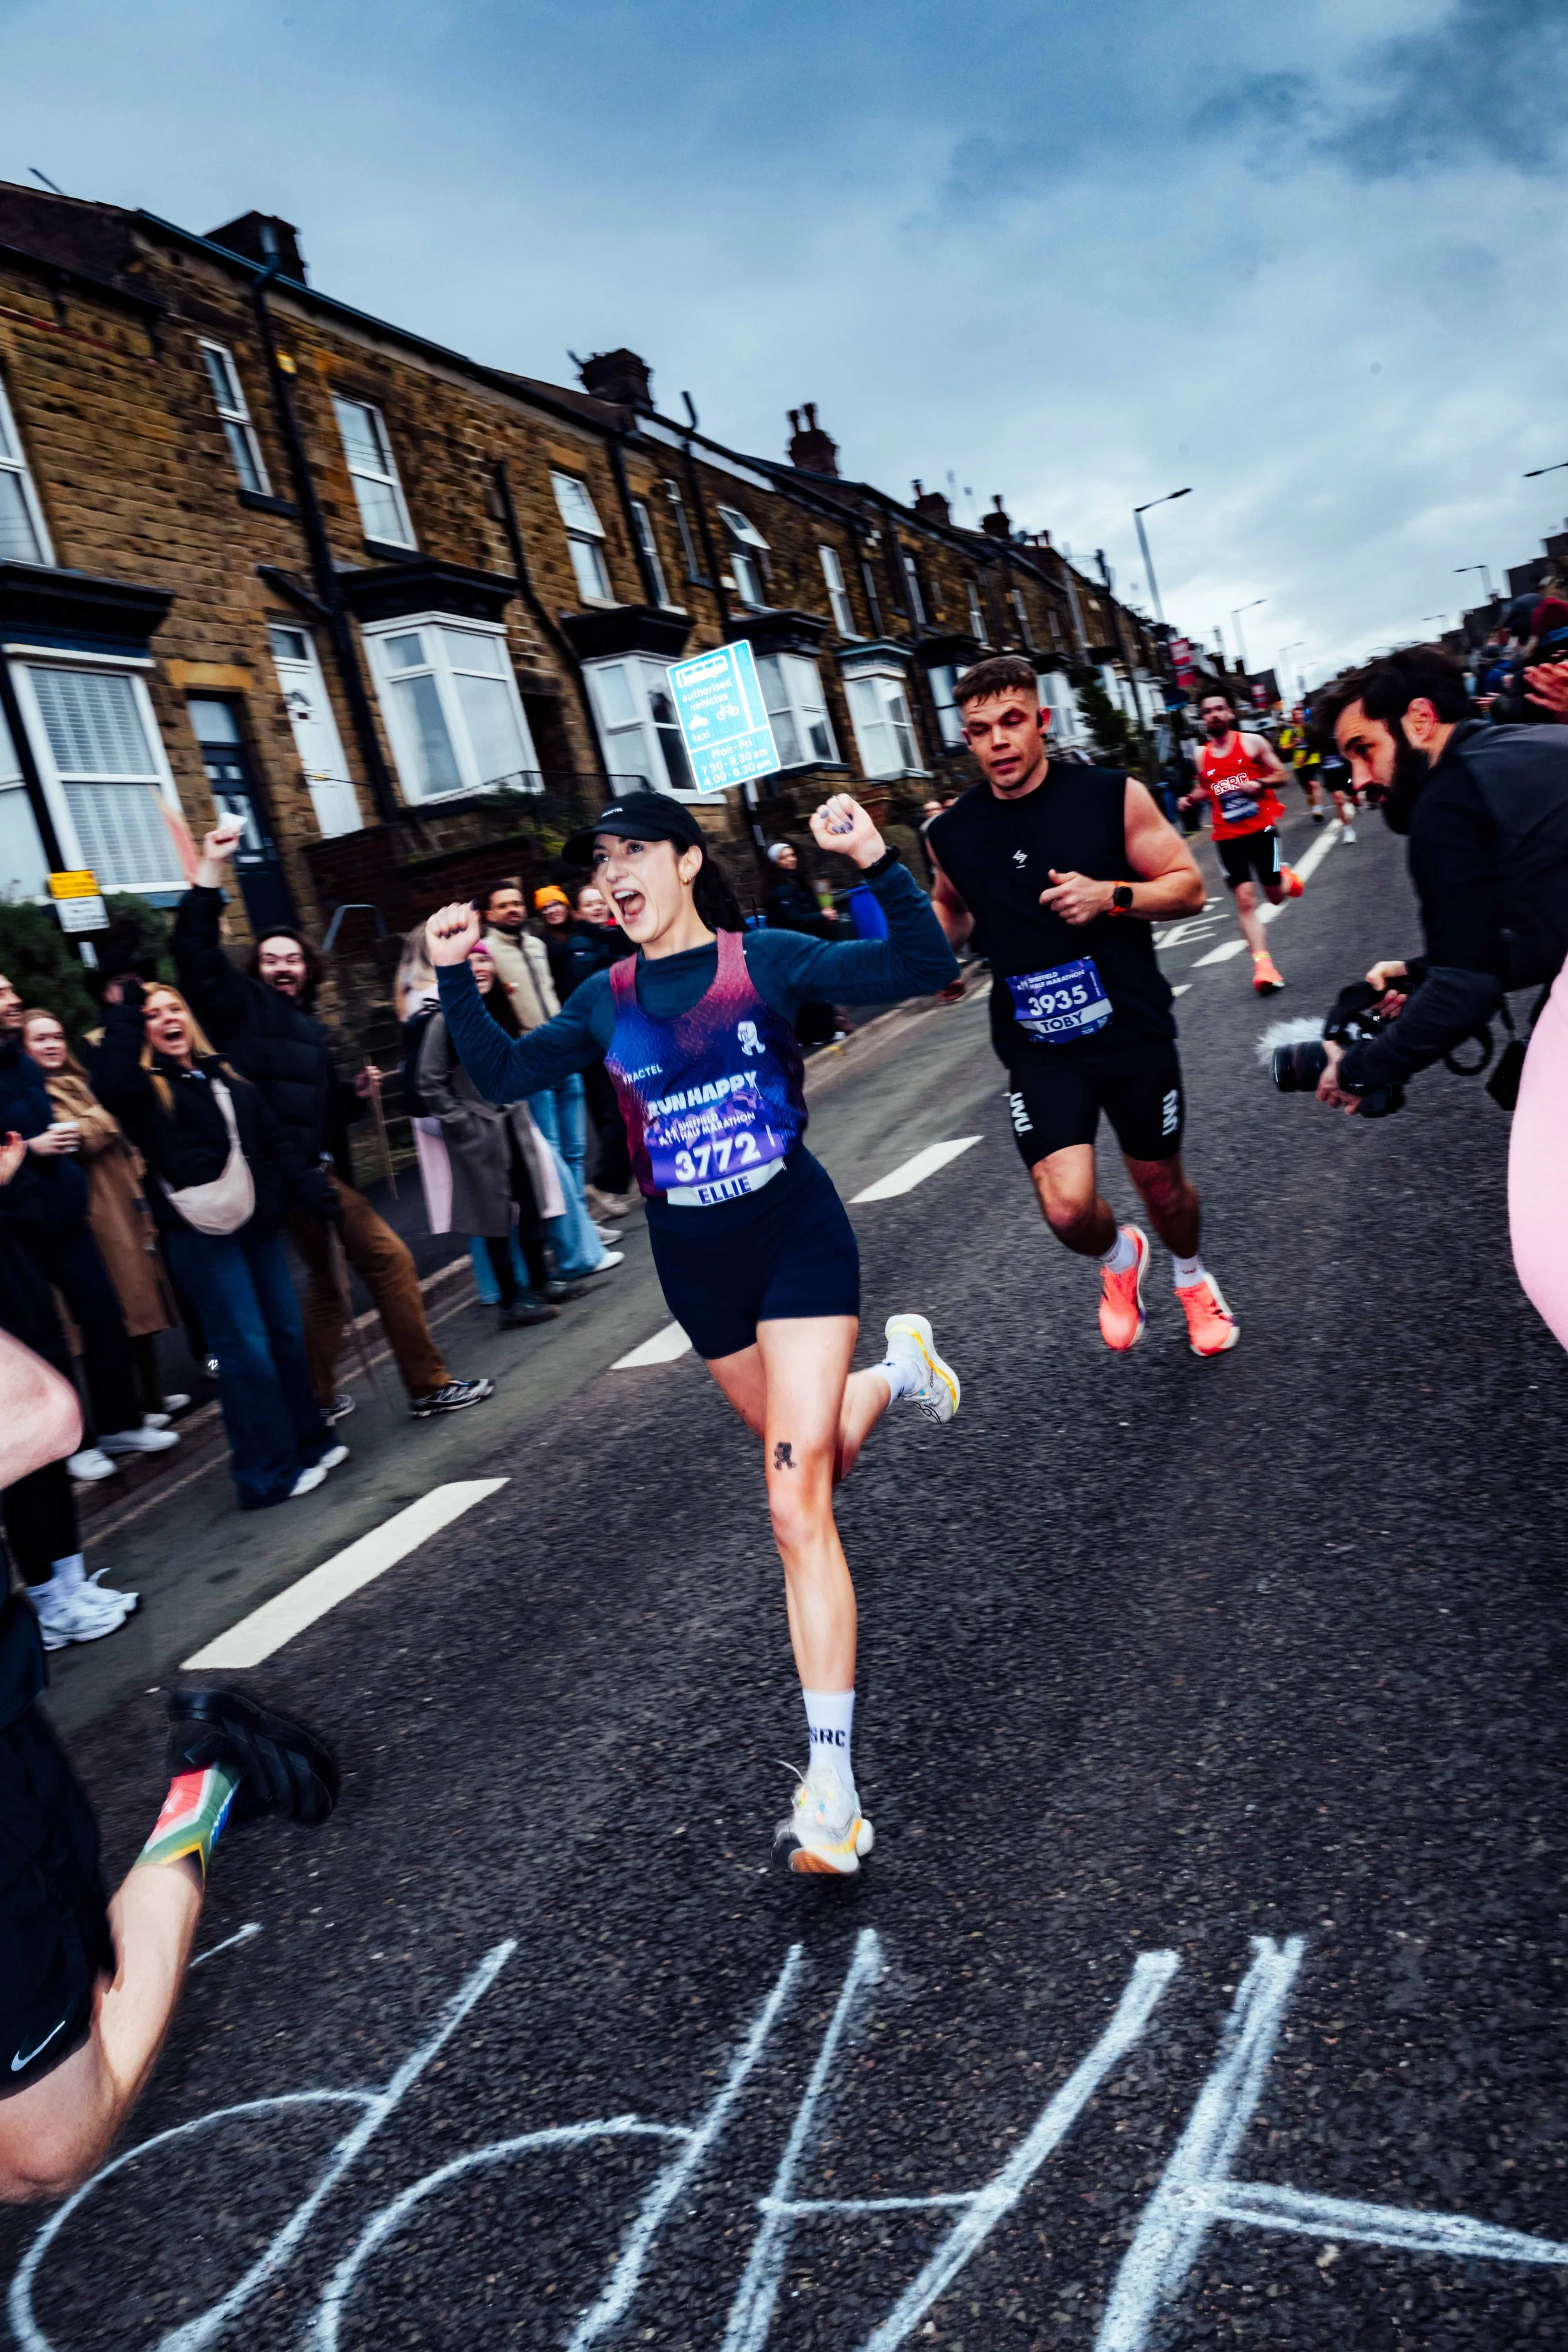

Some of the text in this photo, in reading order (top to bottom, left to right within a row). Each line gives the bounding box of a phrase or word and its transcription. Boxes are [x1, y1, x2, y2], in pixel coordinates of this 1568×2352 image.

[682, 678, 733, 702] authorised
[691, 693, 728, 711] vehicles
[692, 729, 711, 743] taxi
[711, 746, 733, 758] Mon
[739, 737, 752, 750] Fri
[701, 761, 723, 775] 7.30
[729, 751, 752, 766] 9.30
[753, 748, 768, 759] am
[704, 771, 727, 786] 4.00
[733, 762, 756, 777] 6.30
[757, 759, 772, 771] pm
[1028, 972, 1058, 983] SHEFFIELD
[1030, 982, 1046, 990] HALF
[1046, 970, 1085, 986] MARATHON
[1028, 984, 1088, 1016] 3935
[1041, 1011, 1083, 1031] TOBY
[647, 1071, 757, 1121] RUN HAPPY
[678, 1113, 719, 1131] SHEFFIELD
[680, 1111, 755, 1141] HALF MARATHON
[675, 1131, 761, 1182] 3772
[697, 1175, 751, 1204] ELLIE
